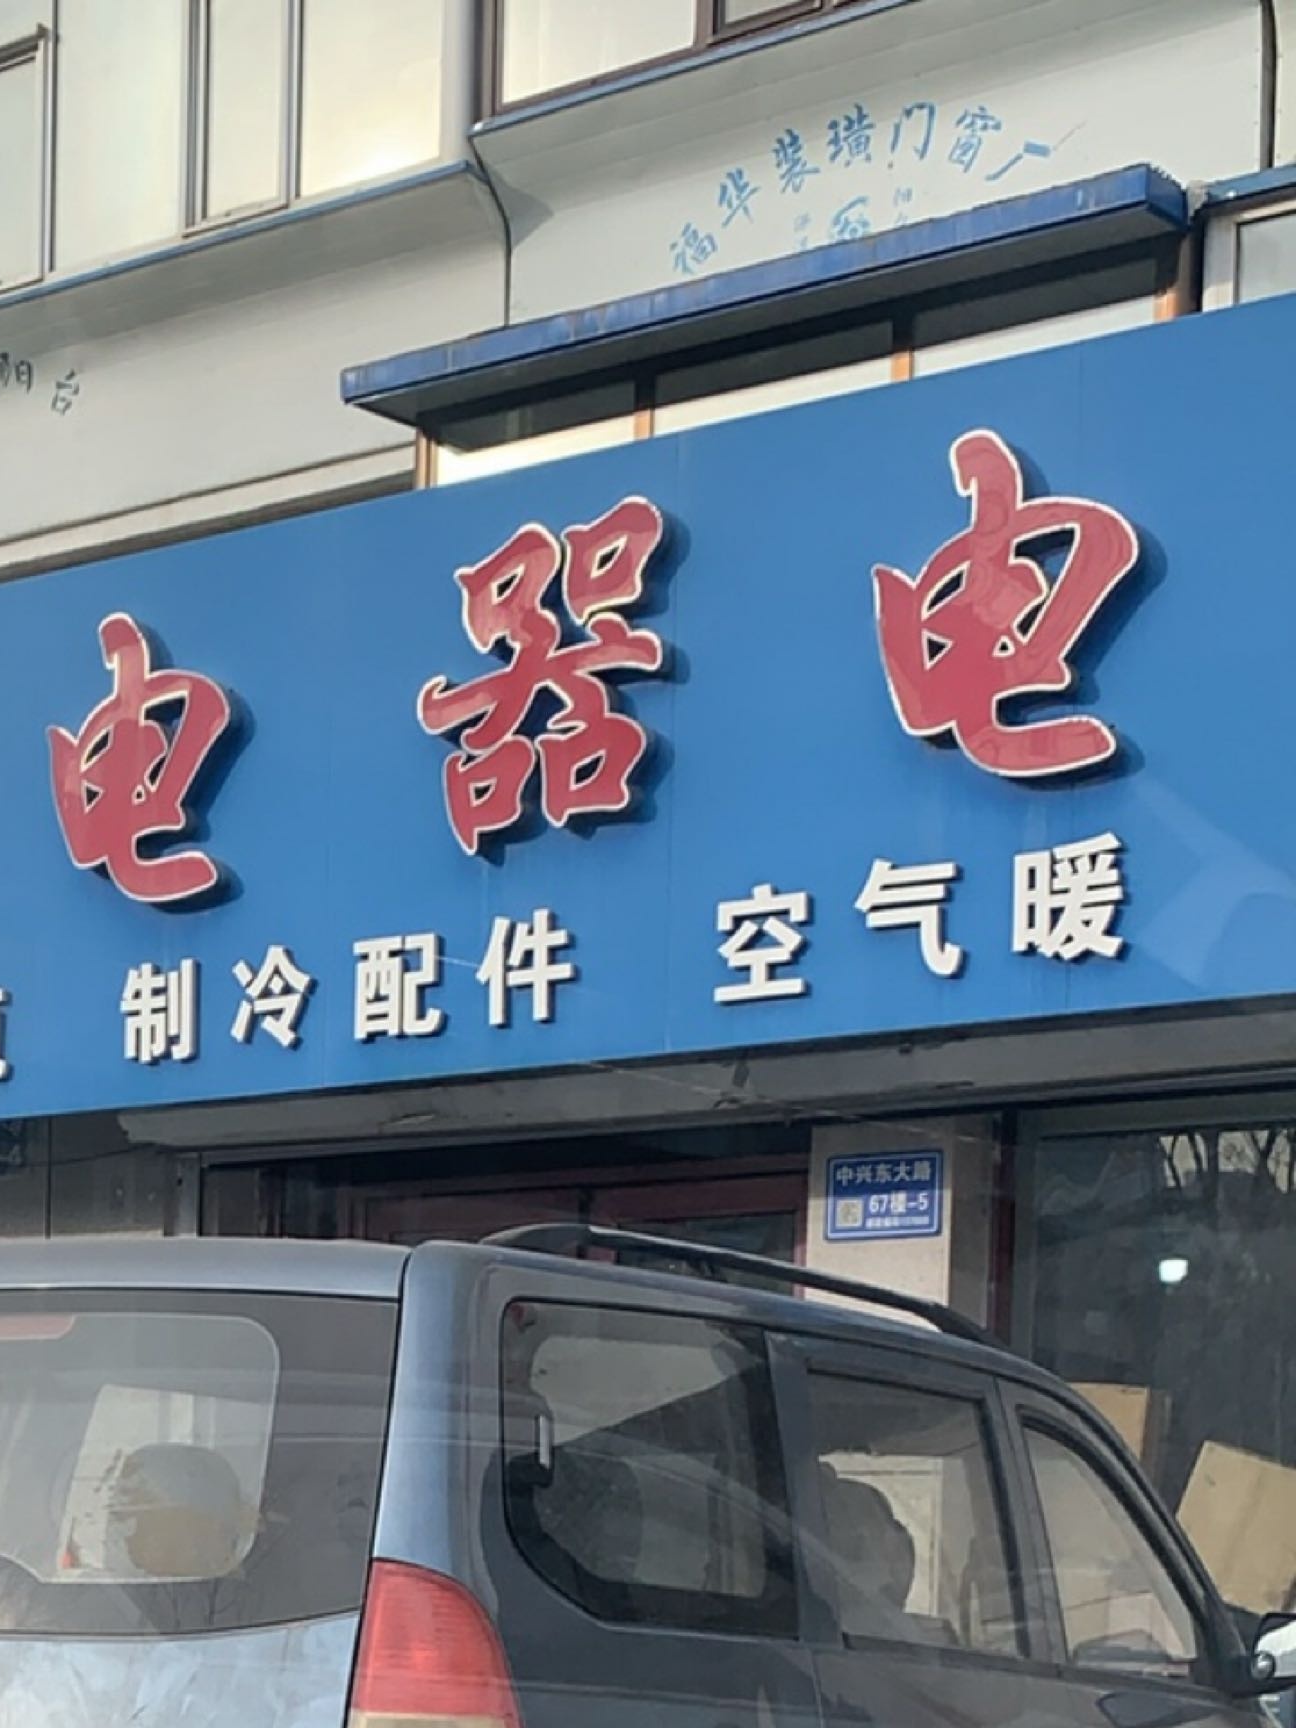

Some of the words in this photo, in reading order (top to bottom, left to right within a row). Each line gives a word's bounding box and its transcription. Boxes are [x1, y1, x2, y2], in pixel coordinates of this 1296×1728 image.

[120, 907, 575, 1064] 制冷配件
[713, 832, 1125, 1003] 空气暖
